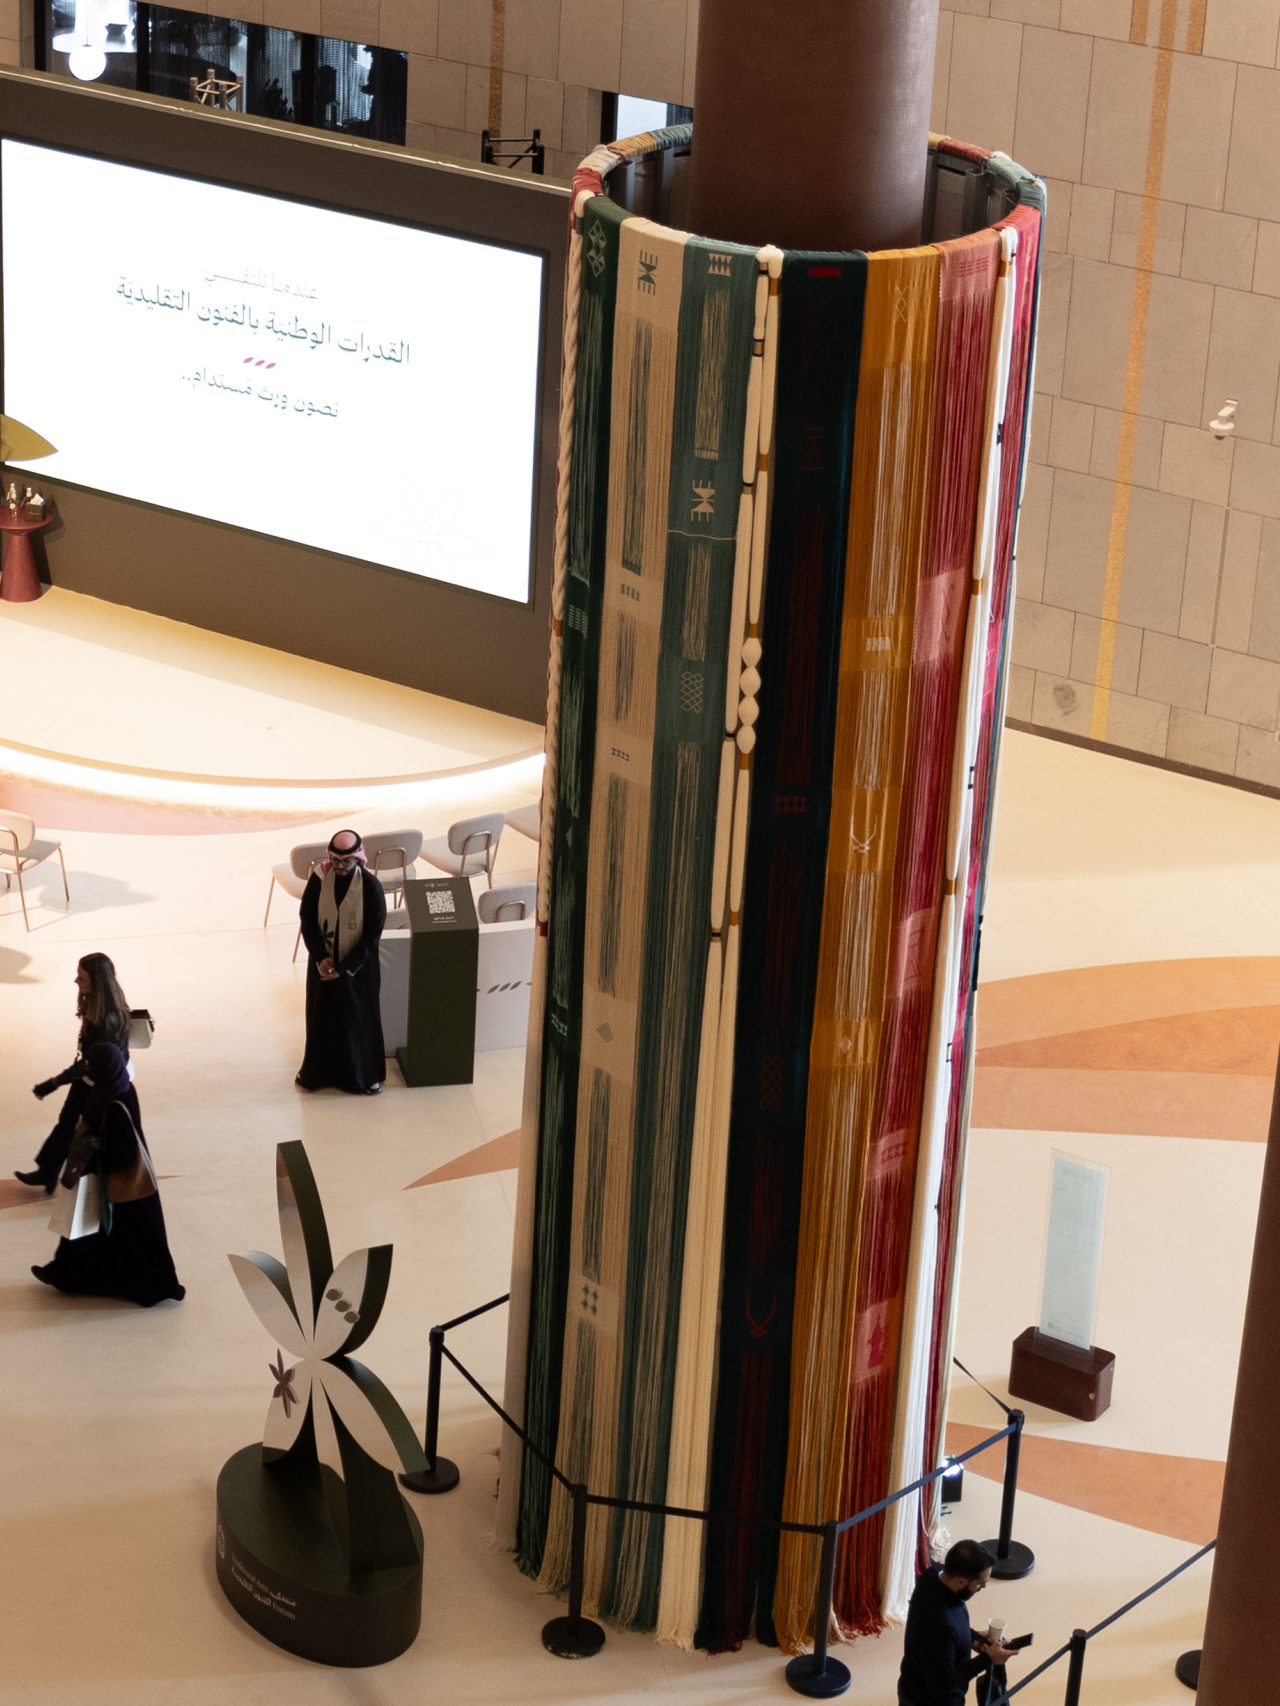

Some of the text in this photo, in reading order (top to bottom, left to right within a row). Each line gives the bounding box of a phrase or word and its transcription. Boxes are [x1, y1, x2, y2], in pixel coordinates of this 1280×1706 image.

[116, 275, 410, 364] القدرات الوطنية بالفنون التقليدية
[293, 399, 338, 418] نصون
